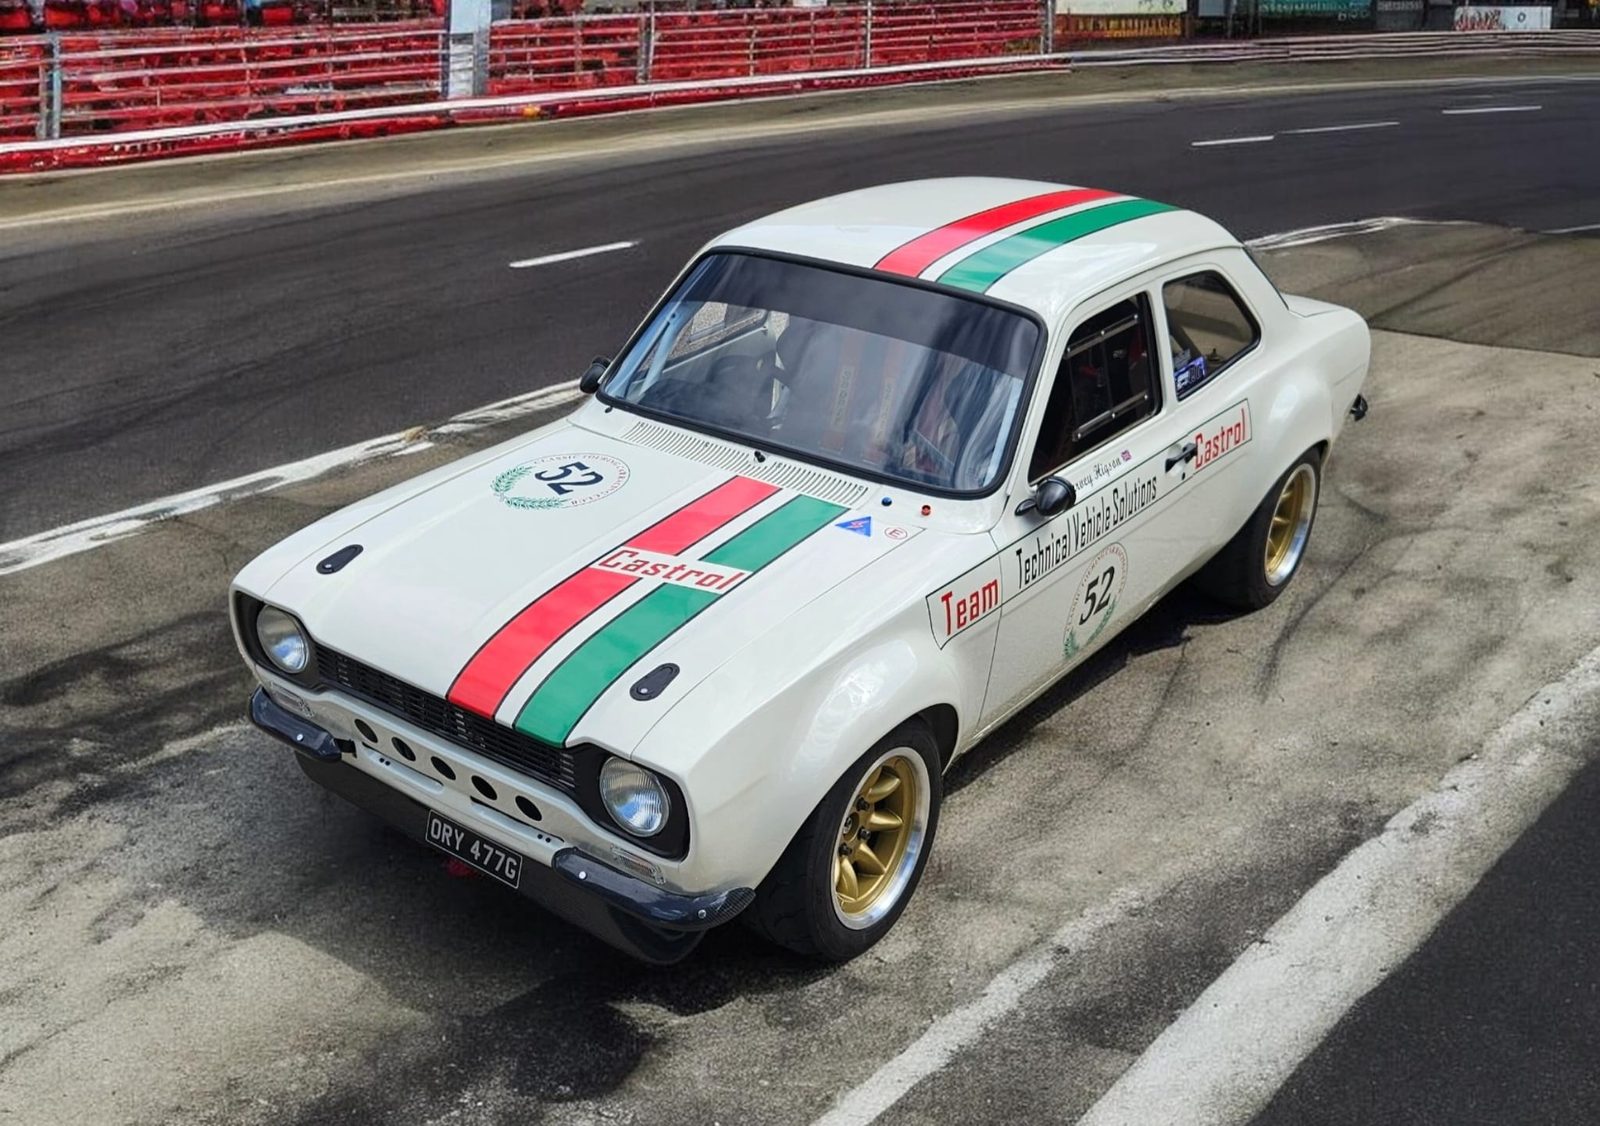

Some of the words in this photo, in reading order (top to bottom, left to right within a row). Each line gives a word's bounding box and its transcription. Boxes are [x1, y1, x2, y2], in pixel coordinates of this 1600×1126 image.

[1194, 408, 1246, 469] Castrol
[534, 461, 604, 495] 52
[888, 528, 904, 538] E
[1016, 517, 1071, 589] Technical
[1073, 496, 1111, 552] Vehicle
[1112, 476, 1157, 526] Solutions
[598, 549, 745, 590] Castrol
[1078, 566, 1115, 626] 52
[941, 579, 998, 636] Team
[430, 818, 465, 851] ORY
[470, 840, 518, 880] 477G
